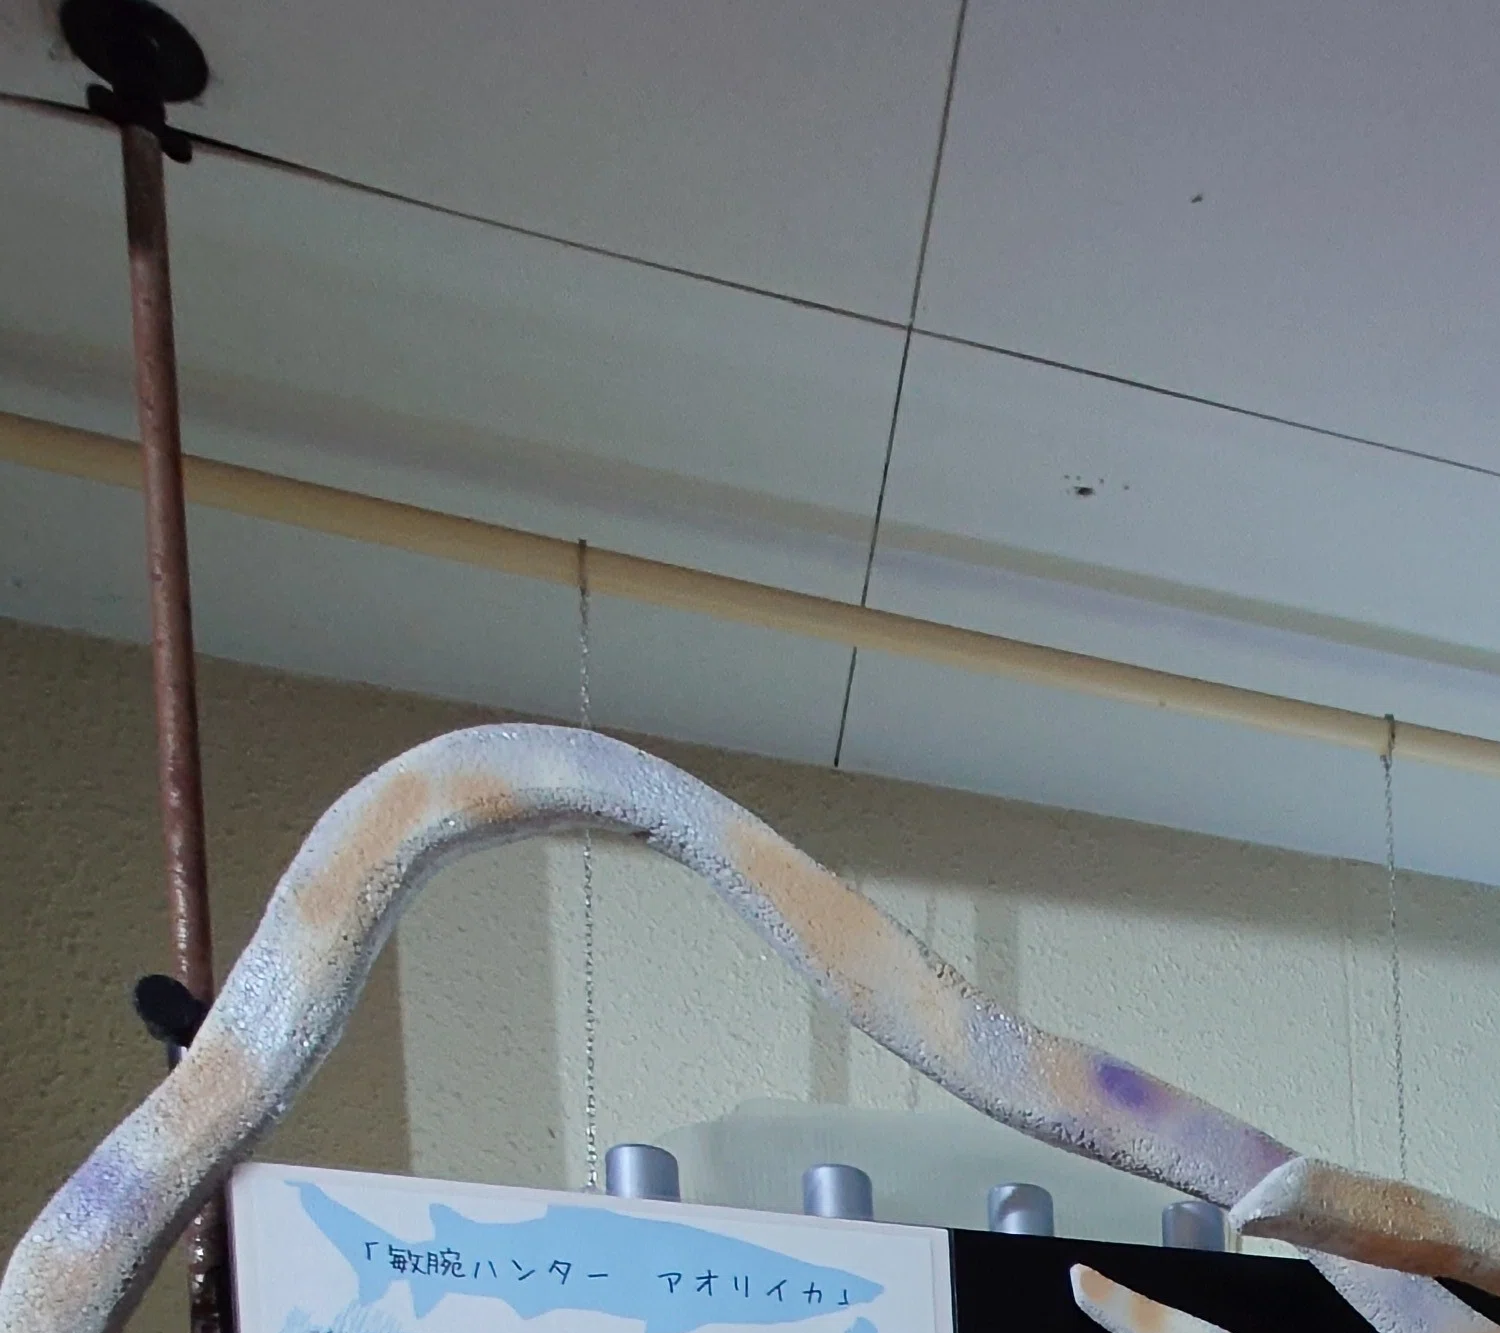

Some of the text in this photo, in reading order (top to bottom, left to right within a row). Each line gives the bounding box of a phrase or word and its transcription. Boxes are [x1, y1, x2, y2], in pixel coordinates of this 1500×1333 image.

[364, 1240, 850, 1306] 「敏腕ハンター アオリイカ」
